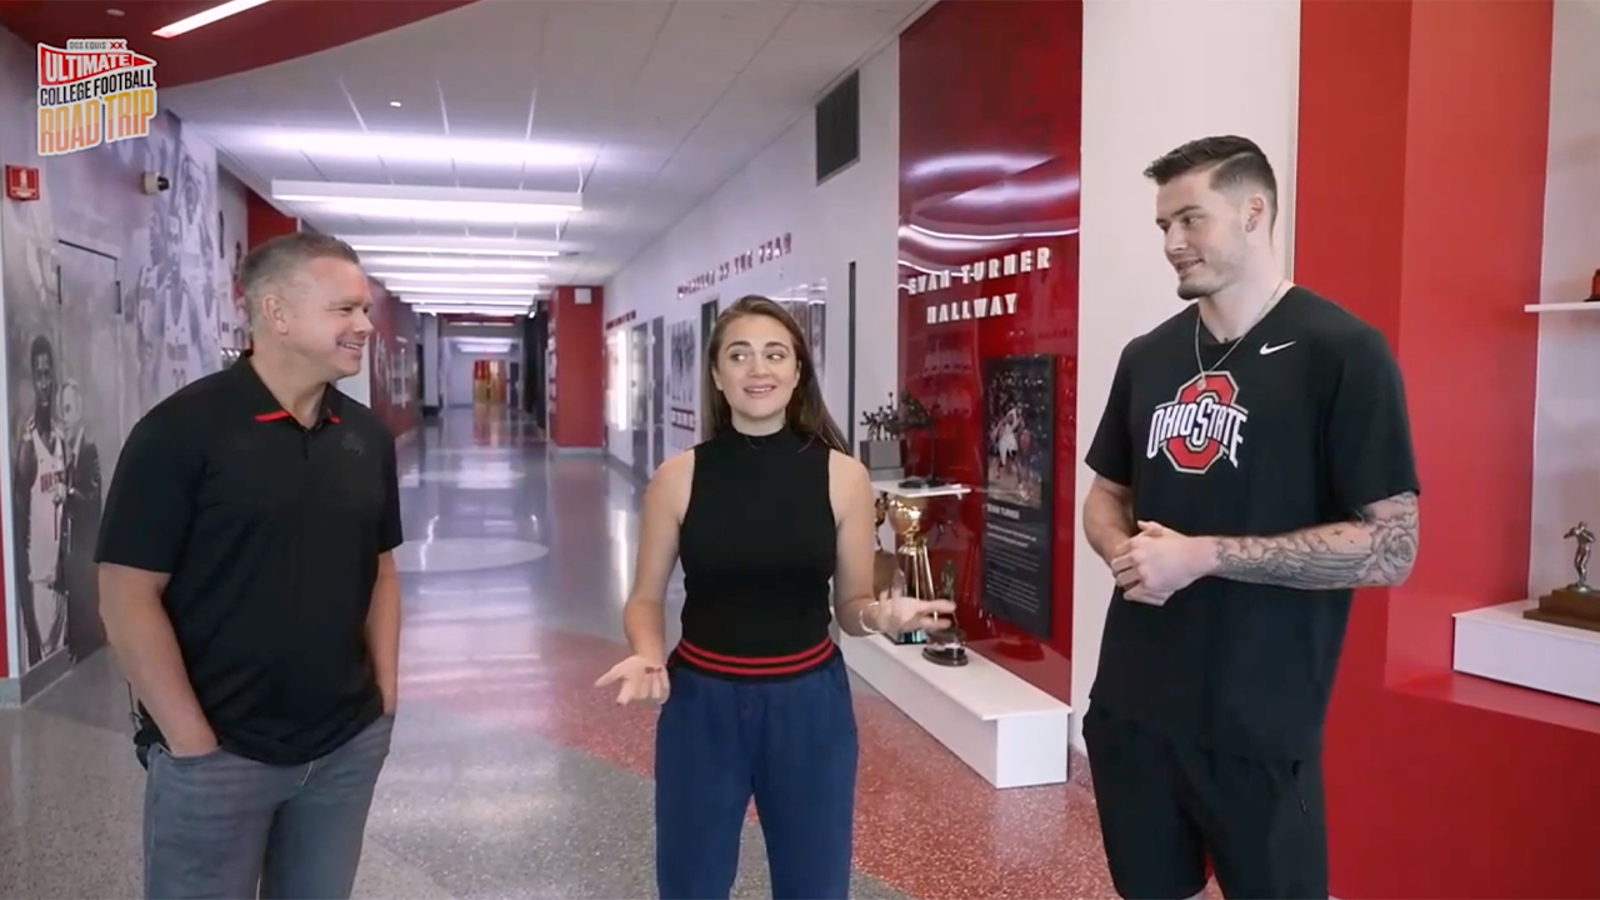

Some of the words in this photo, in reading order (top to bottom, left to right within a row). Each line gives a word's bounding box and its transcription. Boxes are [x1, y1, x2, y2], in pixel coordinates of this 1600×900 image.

[908, 269, 950, 295] EVAN
[961, 246, 1050, 284] TURNER
[926, 293, 1018, 324] HALLWAY
